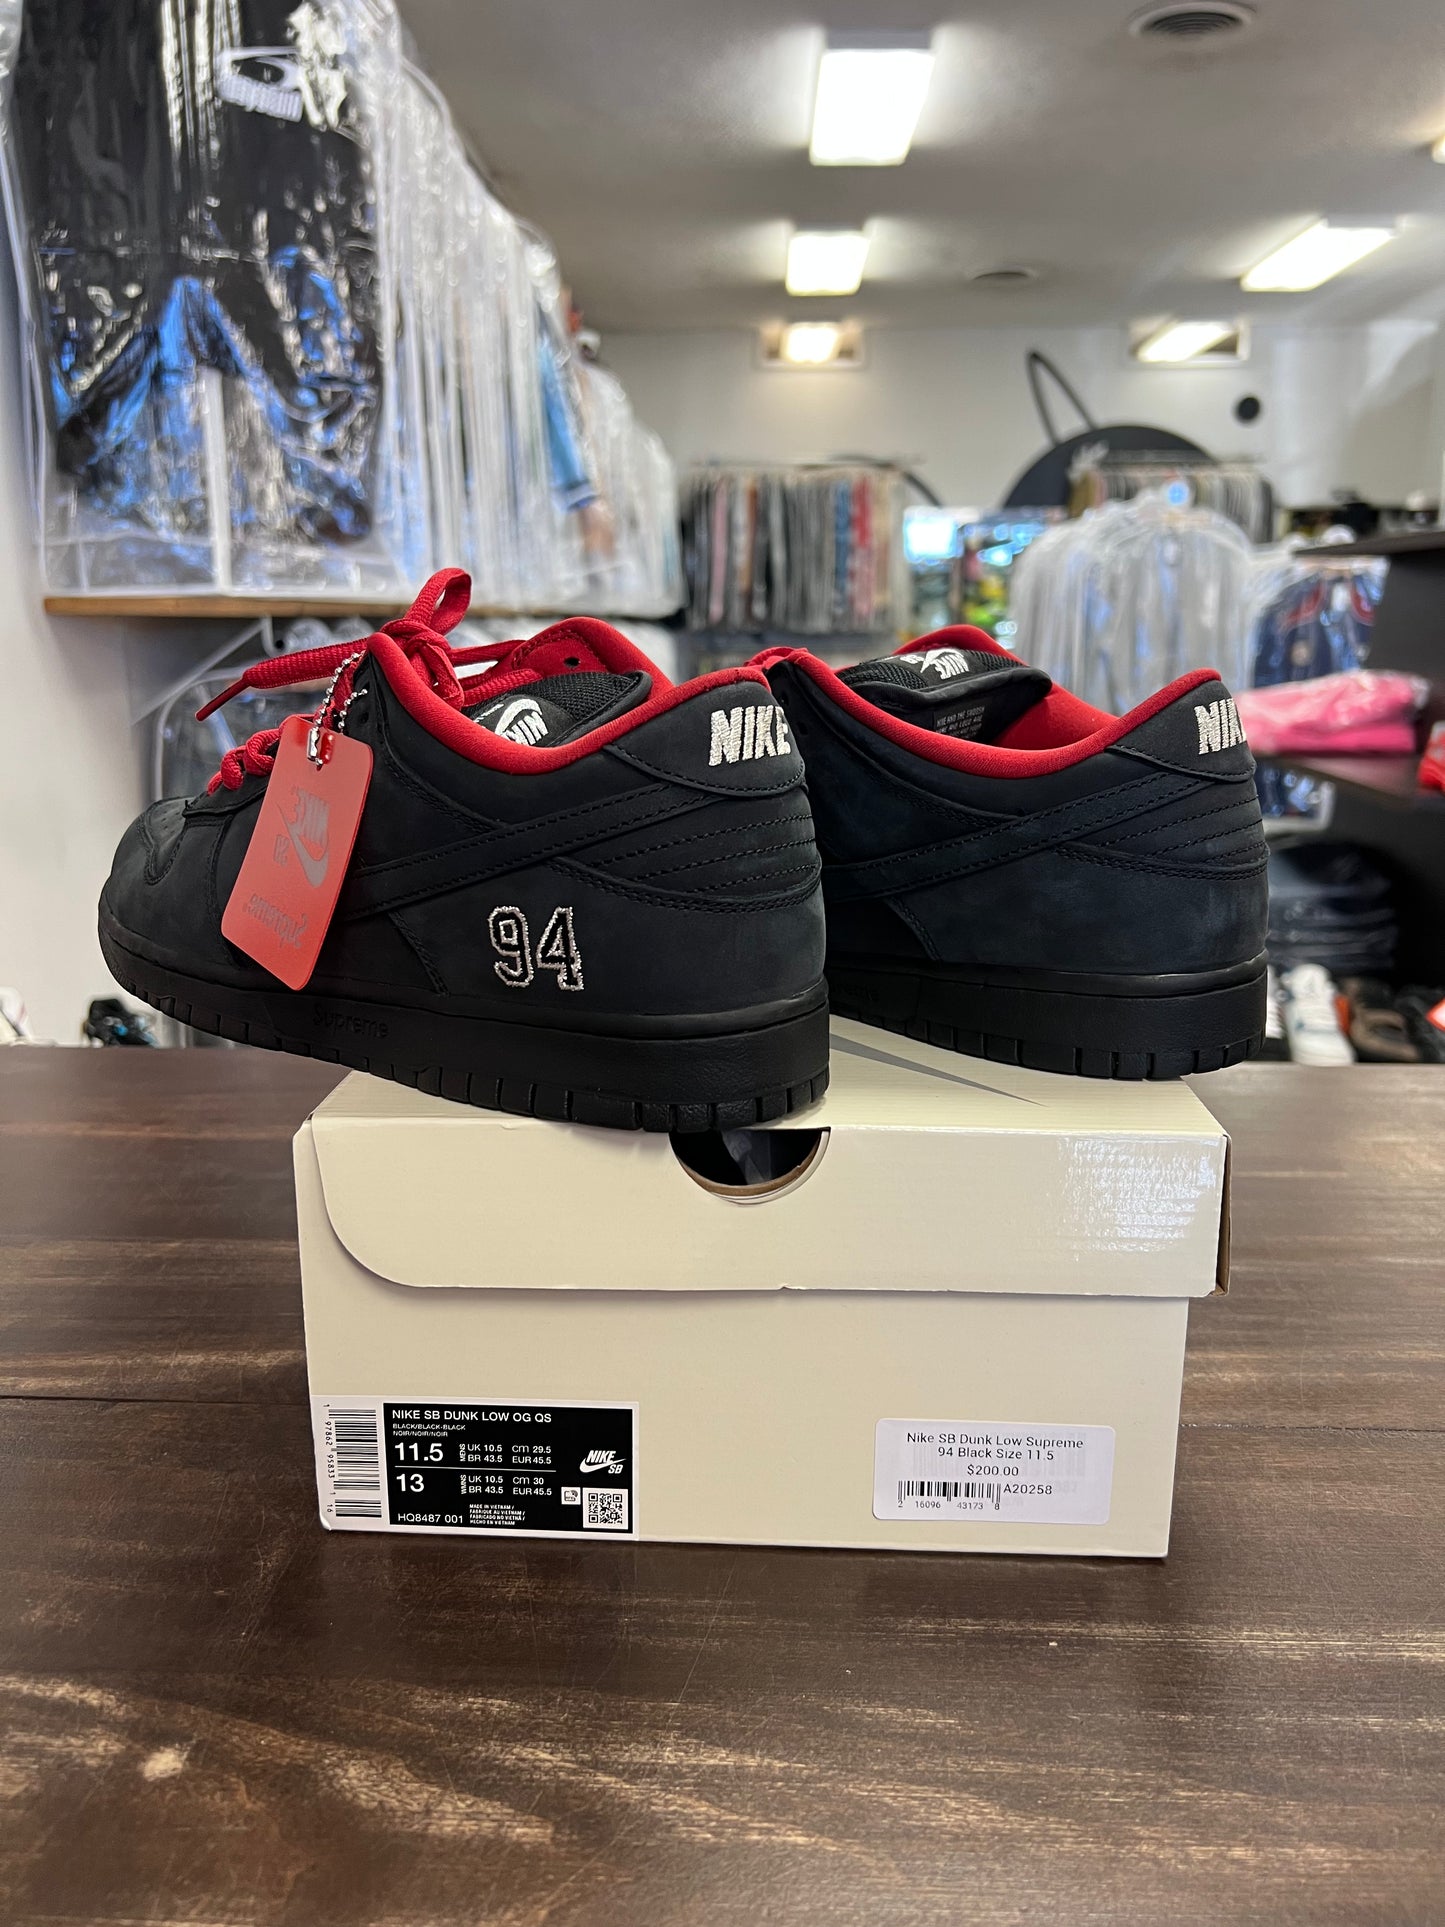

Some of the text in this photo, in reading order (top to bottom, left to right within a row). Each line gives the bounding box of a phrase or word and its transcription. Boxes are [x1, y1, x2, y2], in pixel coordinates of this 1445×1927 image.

[1193, 697, 1247, 755] NIK
[708, 704, 792, 767] NIKE
[487, 905, 585, 991] 94
[392, 1409, 552, 1423] NIKE SB DUNK LOW OG QS
[906, 1432, 1084, 1449] Nike SB Dunk Low Supreme
[394, 1442, 444, 1462] 11.5
[467, 1444, 503, 1452] UK 10.5
[532, 1445, 552, 1454] 29.5
[937, 1447, 1054, 1461] 94 Black Size 11.5
[467, 1454, 503, 1463] BR 43.5
[512, 1456, 552, 1465] EUR 45.5
[585, 1450, 617, 1464] NIKE
[327, 1454, 335, 1479] 95833
[608, 1464, 624, 1474] SB
[966, 1464, 1019, 1477] $200.00
[396, 1473, 425, 1493] 13
[468, 1475, 504, 1484] UK 10.5
[533, 1477, 545, 1485] 30
[468, 1486, 504, 1494] BR 43.5
[512, 1487, 552, 1496] EUR 45.5
[1003, 1483, 1053, 1495] A20258
[898, 1500, 1000, 1511] 2 16096 43173 8
[398, 1513, 463, 1524] HQ8487 001
